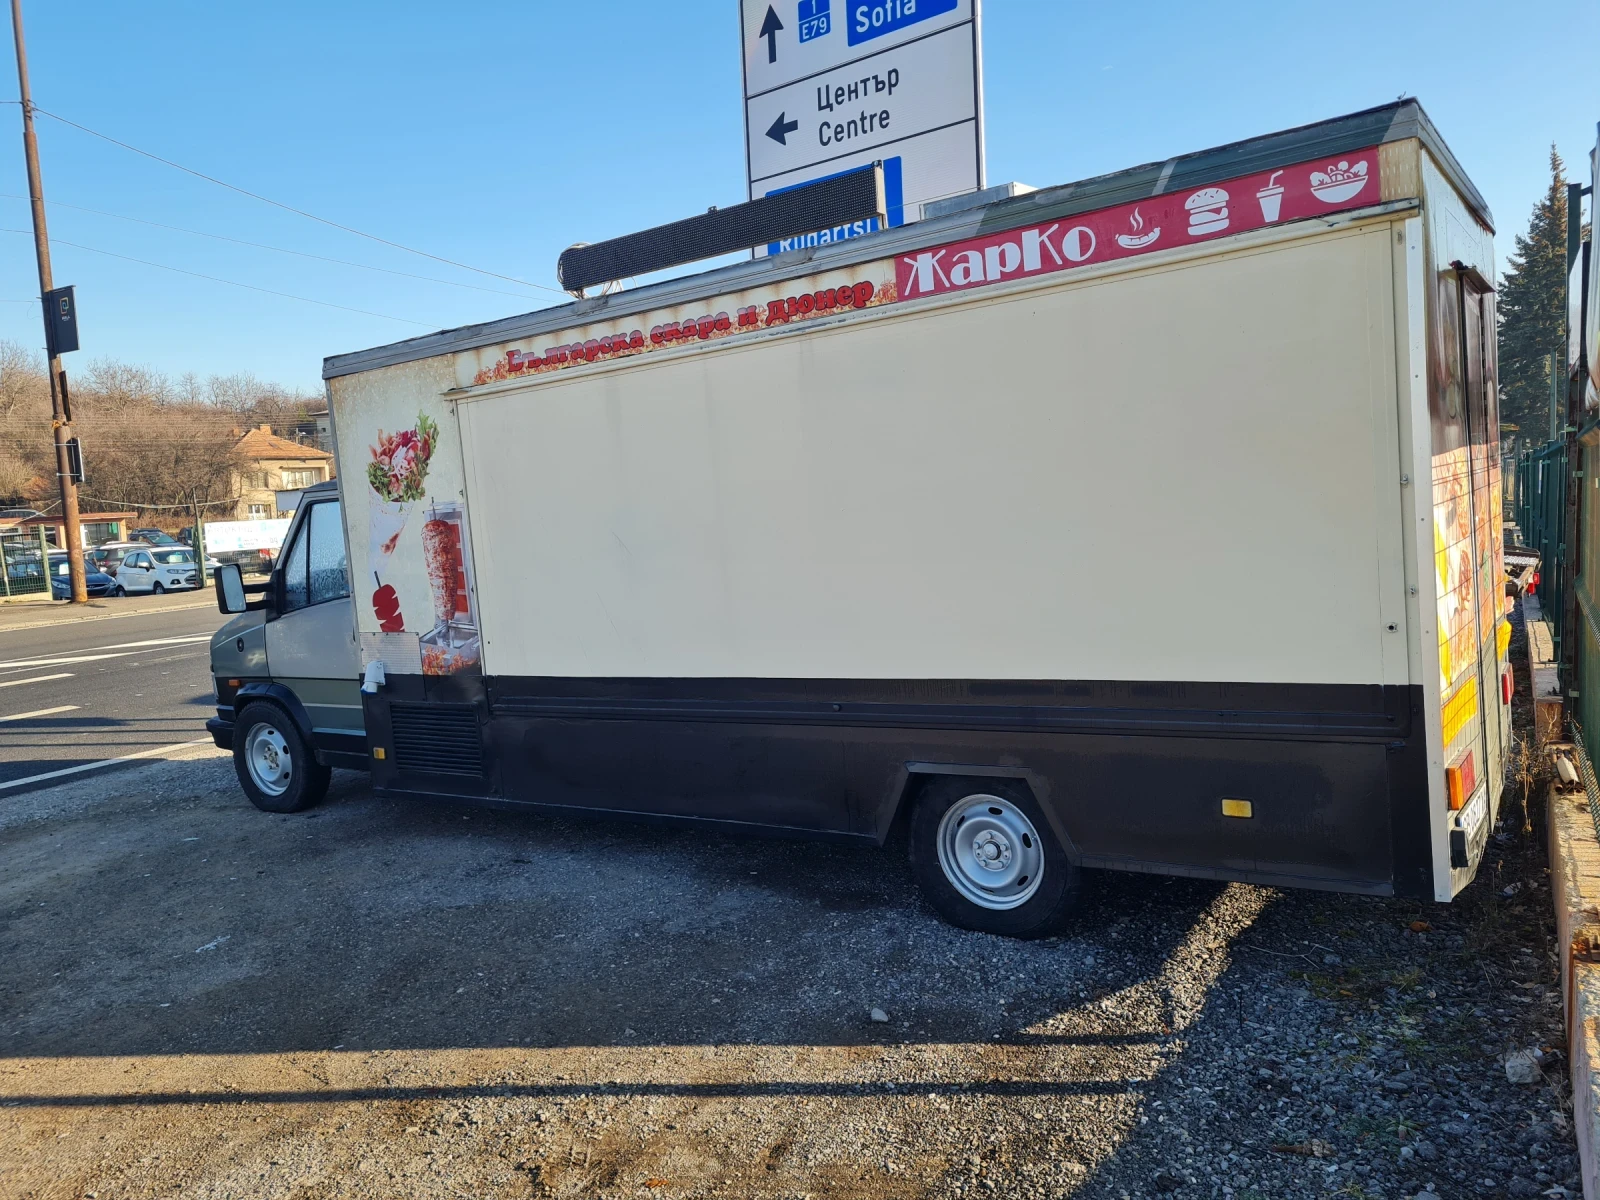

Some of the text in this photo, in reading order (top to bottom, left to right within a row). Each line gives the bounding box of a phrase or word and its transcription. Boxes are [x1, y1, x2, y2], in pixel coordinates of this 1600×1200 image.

[802, 17, 828, 40] E79
[855, 0, 916, 33] Sofia
[817, 68, 899, 112] Център
[818, 109, 890, 146] Centre
[506, 280, 875, 373] Българска скара и дюнер
